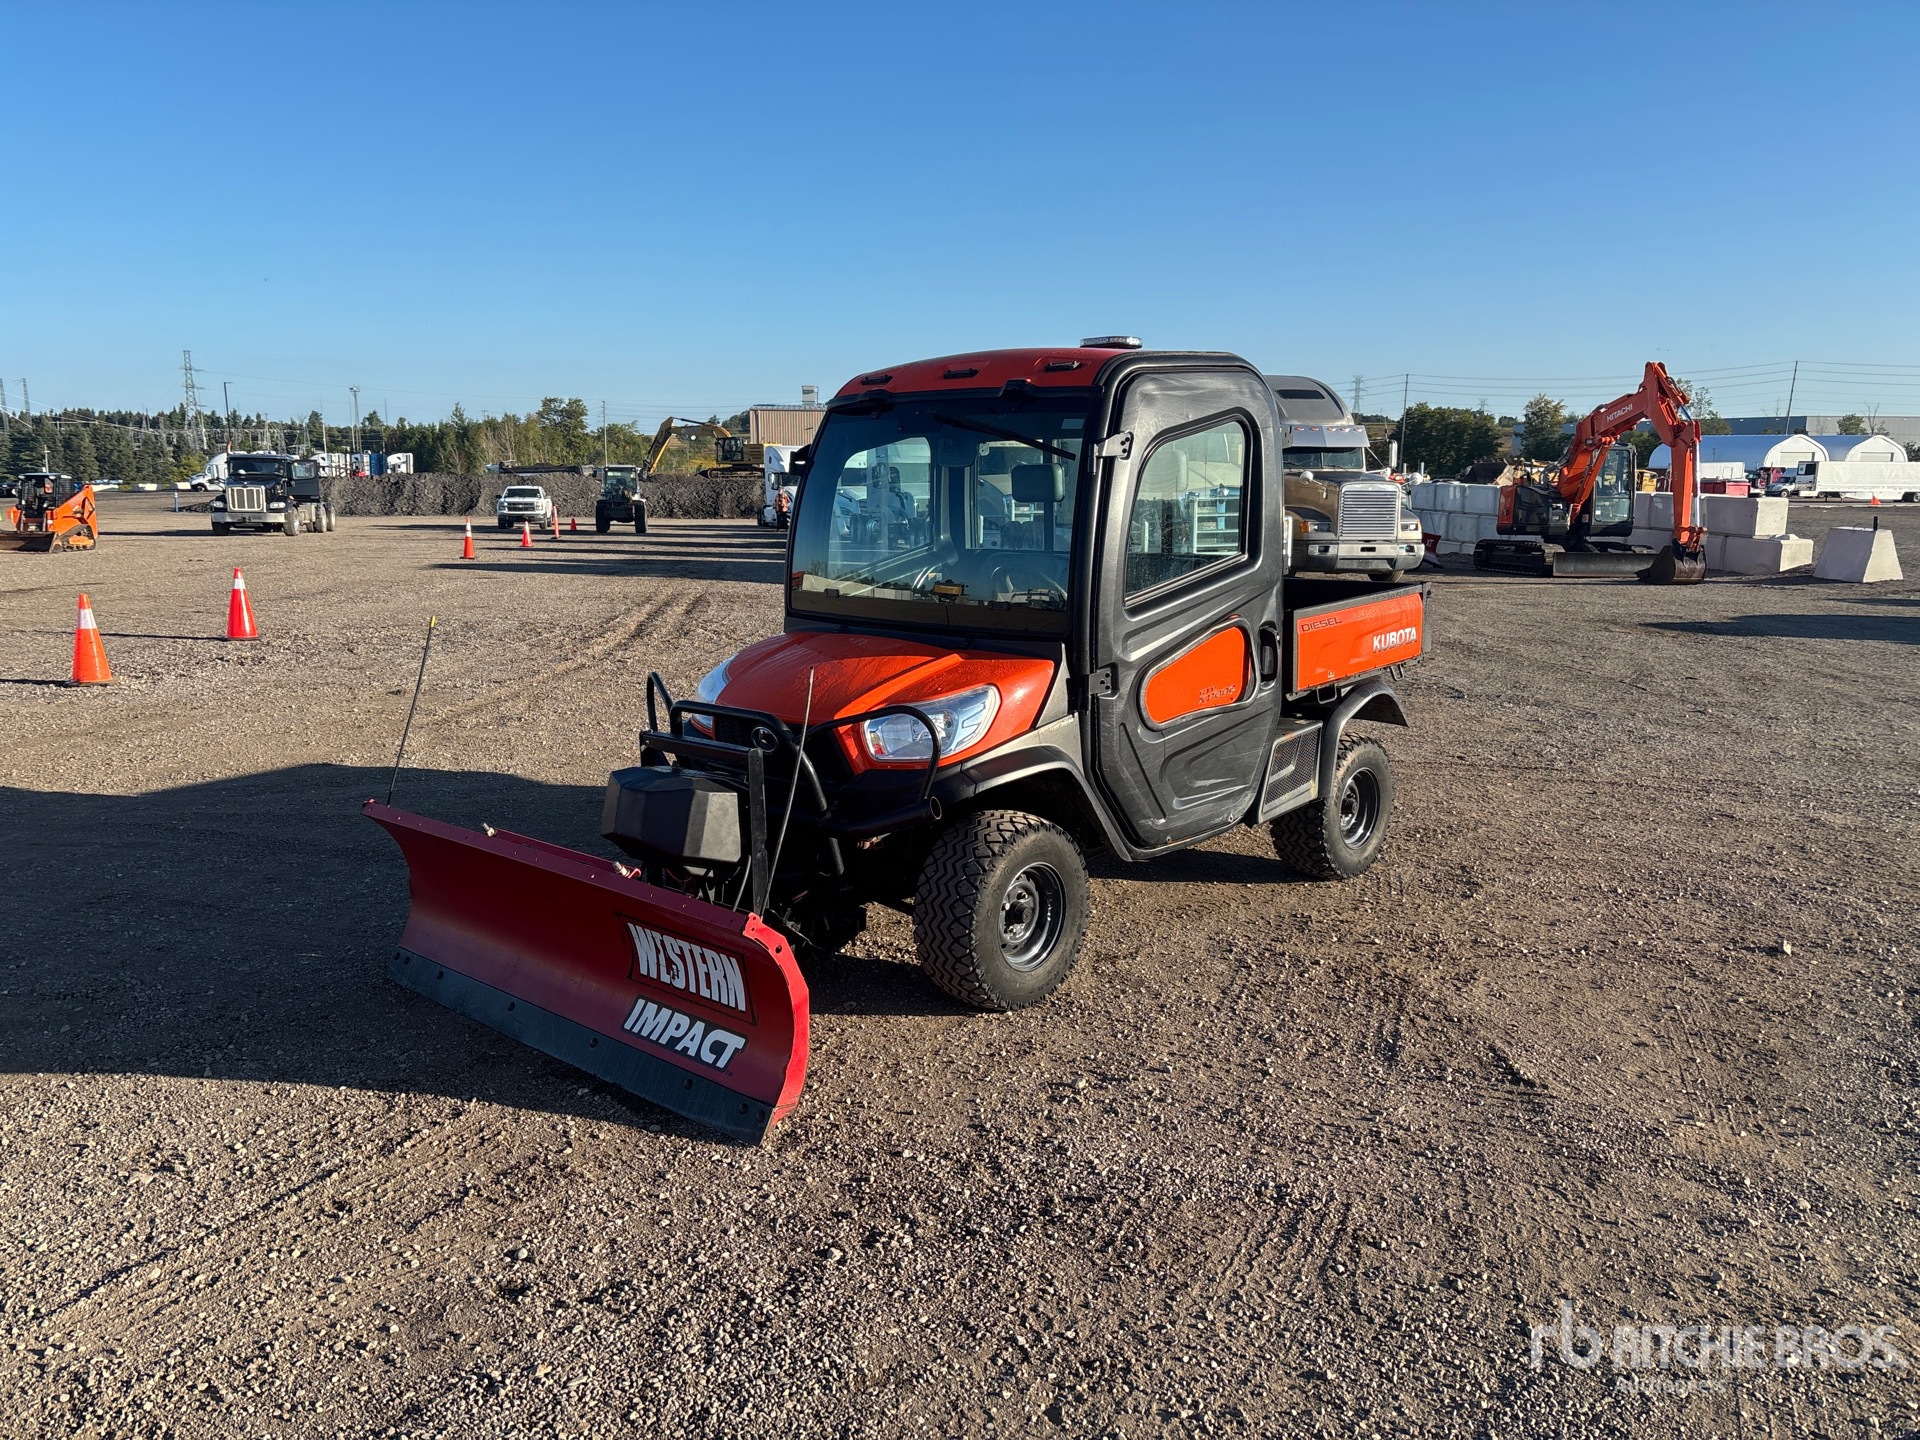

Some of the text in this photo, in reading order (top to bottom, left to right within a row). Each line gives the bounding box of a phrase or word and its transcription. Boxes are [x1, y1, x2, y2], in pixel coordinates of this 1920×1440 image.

[1606, 403, 1633, 422] HITACHI
[1301, 617, 1342, 632] DIESEL
[1373, 627, 1417, 653] KUBOTA
[627, 922, 746, 1012] WESTERN
[624, 998, 746, 1069] IMPACT
